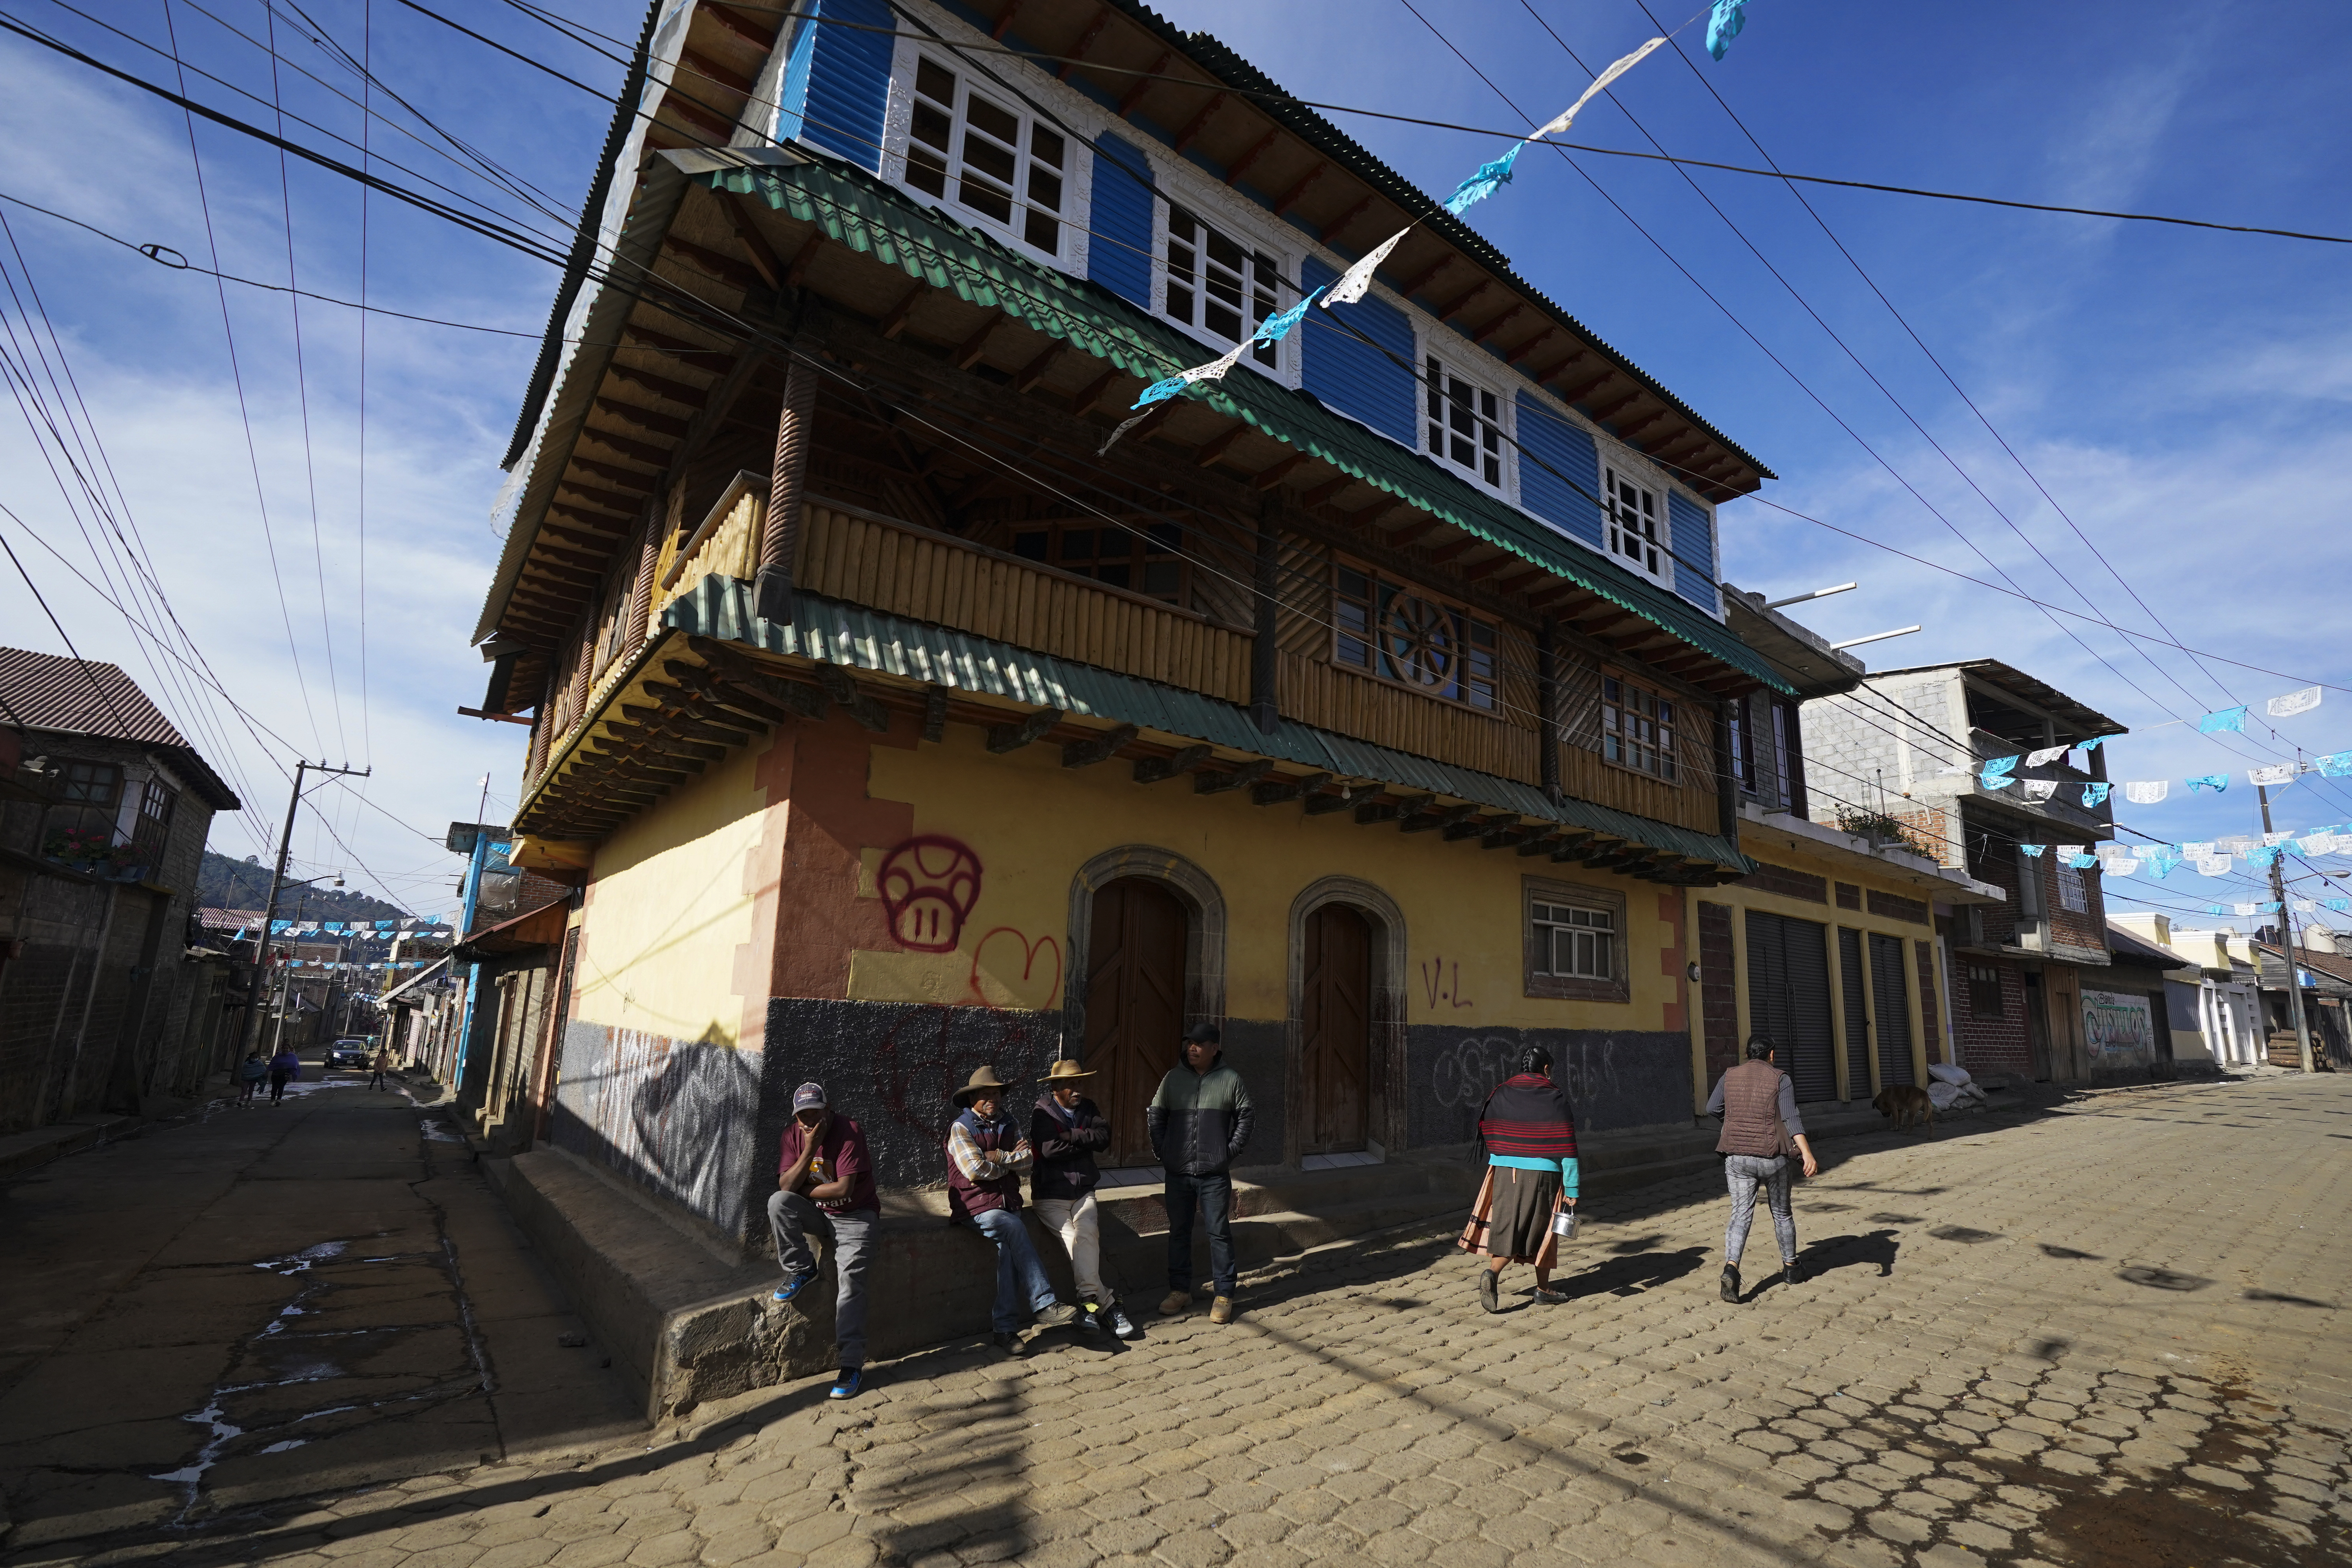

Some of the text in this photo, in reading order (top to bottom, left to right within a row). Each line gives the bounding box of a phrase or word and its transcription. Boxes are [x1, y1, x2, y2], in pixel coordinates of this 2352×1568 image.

[1422, 957, 1473, 1009] V.L
[2097, 992, 2114, 1005] Banda
[815, 1197, 853, 1209] rrari
